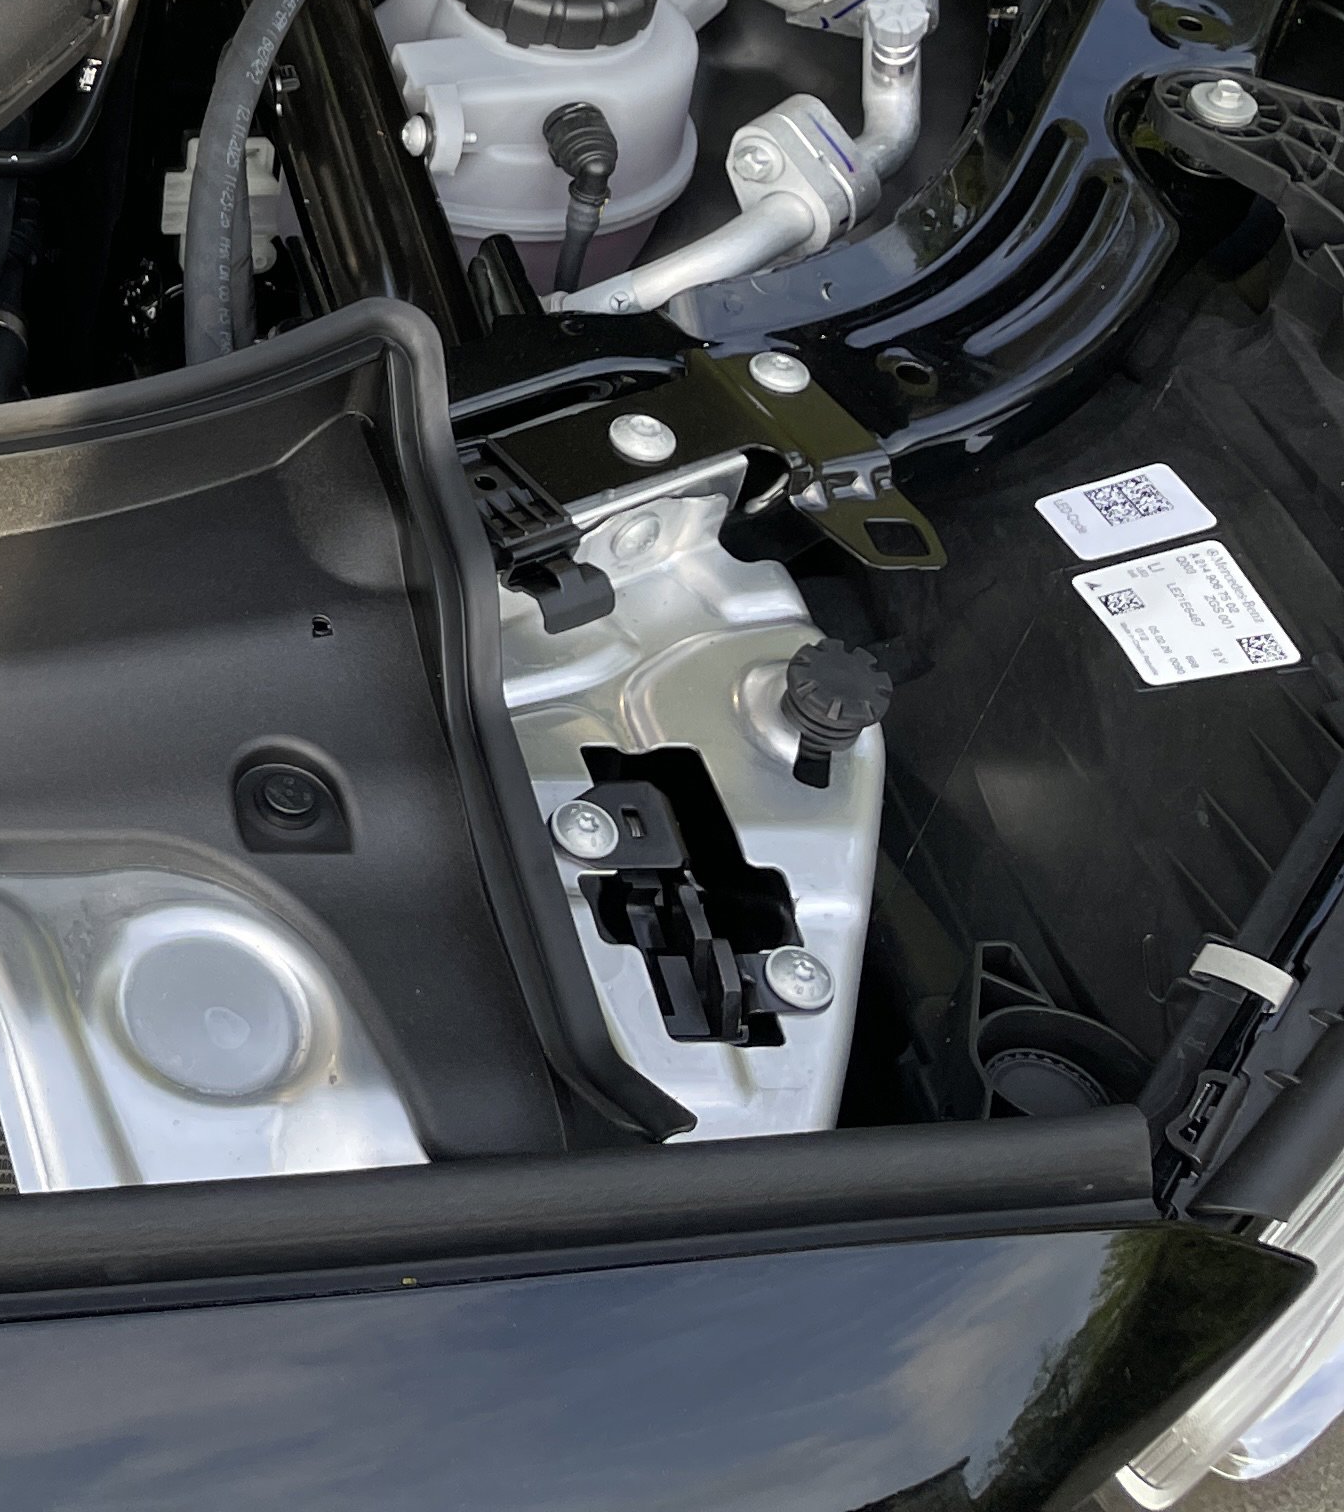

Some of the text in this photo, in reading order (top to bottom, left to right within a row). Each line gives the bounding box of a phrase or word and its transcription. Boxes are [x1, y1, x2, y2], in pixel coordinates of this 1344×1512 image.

[1215, 556, 1265, 623] Mercedes-Benz
[1203, 595, 1225, 614] ZGS
[1217, 614, 1235, 629] 001
[1211, 648, 1223, 657] 12
